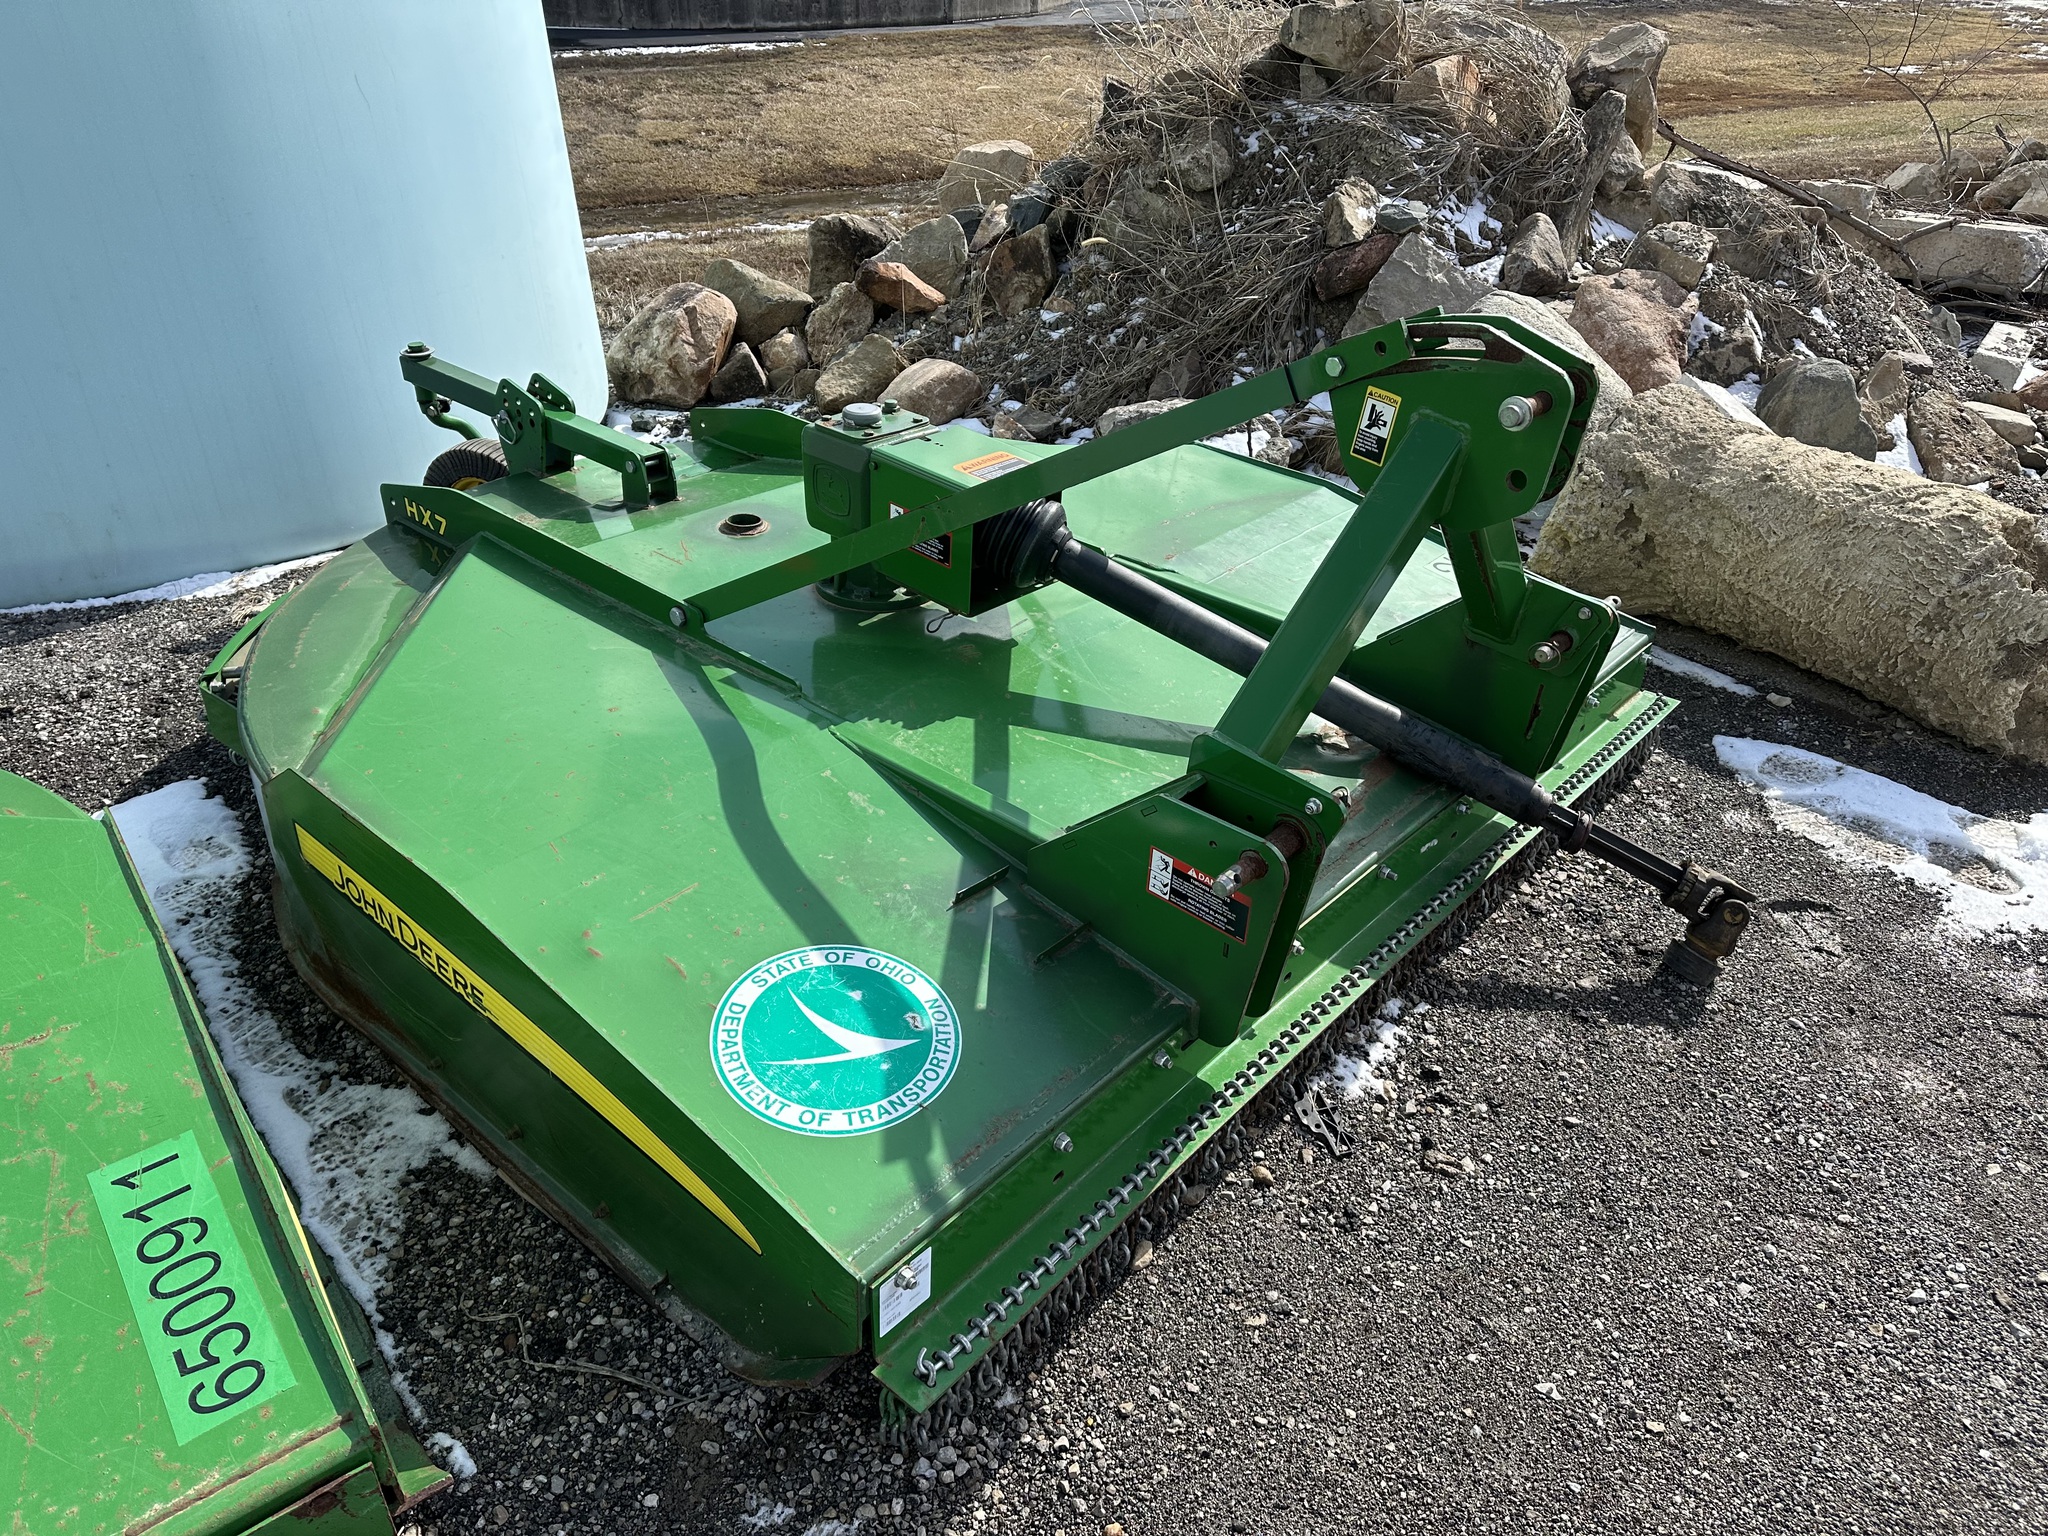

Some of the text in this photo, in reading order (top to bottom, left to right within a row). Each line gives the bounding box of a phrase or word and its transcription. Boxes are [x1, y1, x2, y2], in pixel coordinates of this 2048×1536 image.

[1373, 391, 1399, 406] CAUTION
[966, 453, 1010, 469] WARNING
[404, 497, 447, 536] HX7
[334, 864, 489, 1014] JOHN DEERE
[751, 951, 917, 989] STATE OF OHIO
[720, 997, 952, 1127] DEPARTMENT OF TRANSPORTATION
[110, 1152, 266, 1415] 6500911
